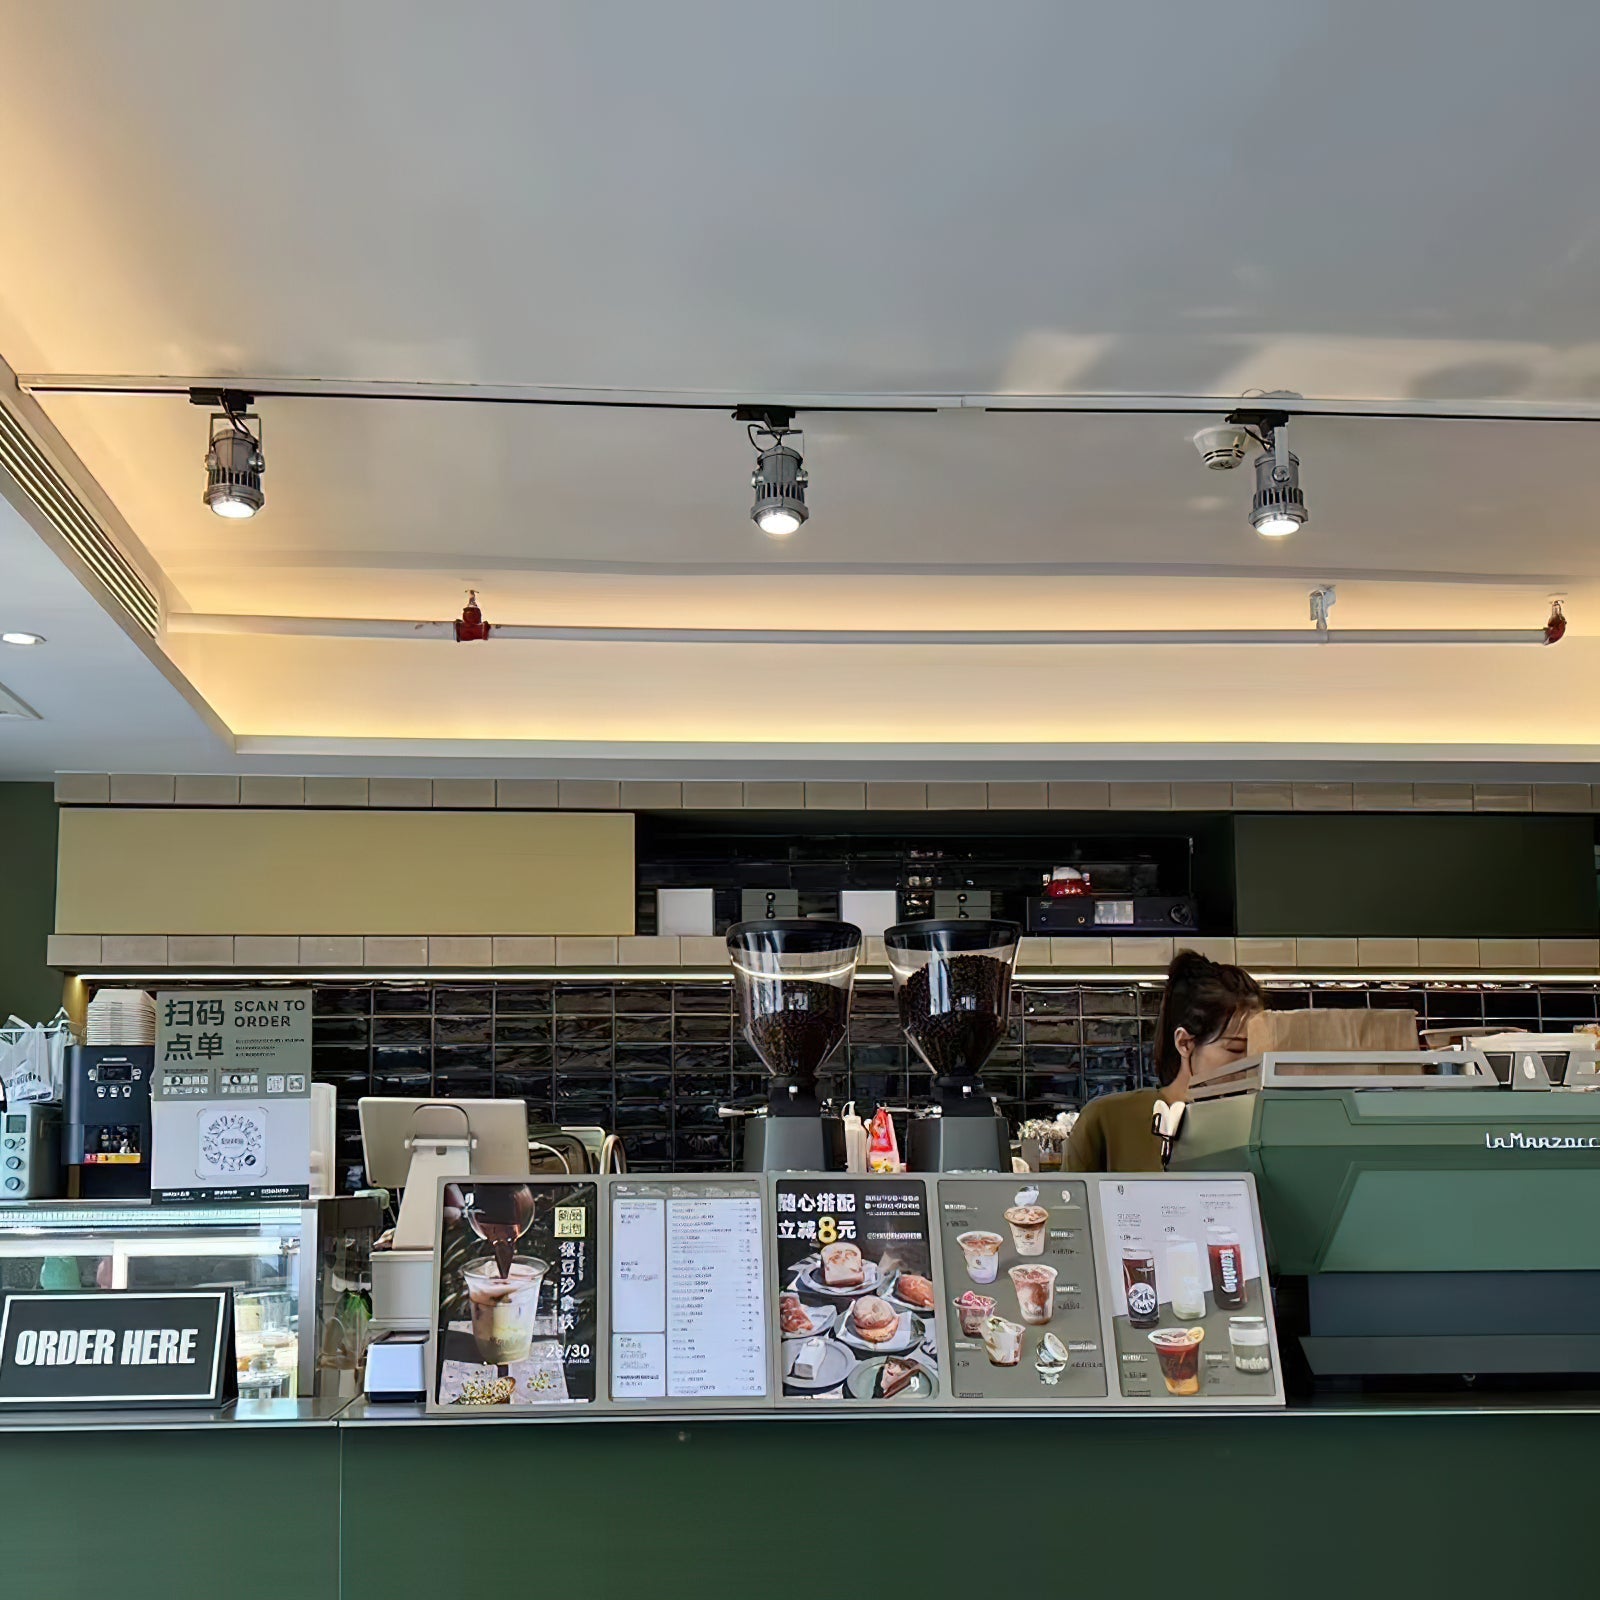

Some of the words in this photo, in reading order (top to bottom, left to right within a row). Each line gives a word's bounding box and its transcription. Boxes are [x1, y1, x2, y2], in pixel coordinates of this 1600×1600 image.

[164, 999, 225, 1027] 扫码
[234, 1000, 279, 1012] SCAN
[283, 1000, 305, 1011] TO
[234, 1015, 291, 1028] ORDER
[164, 1032, 225, 1061] 点单
[777, 1193, 856, 1213] 随心搭配
[777, 1216, 857, 1244] 立减8元
[14, 1329, 116, 1366] ORDER
[120, 1328, 199, 1365] HERE
